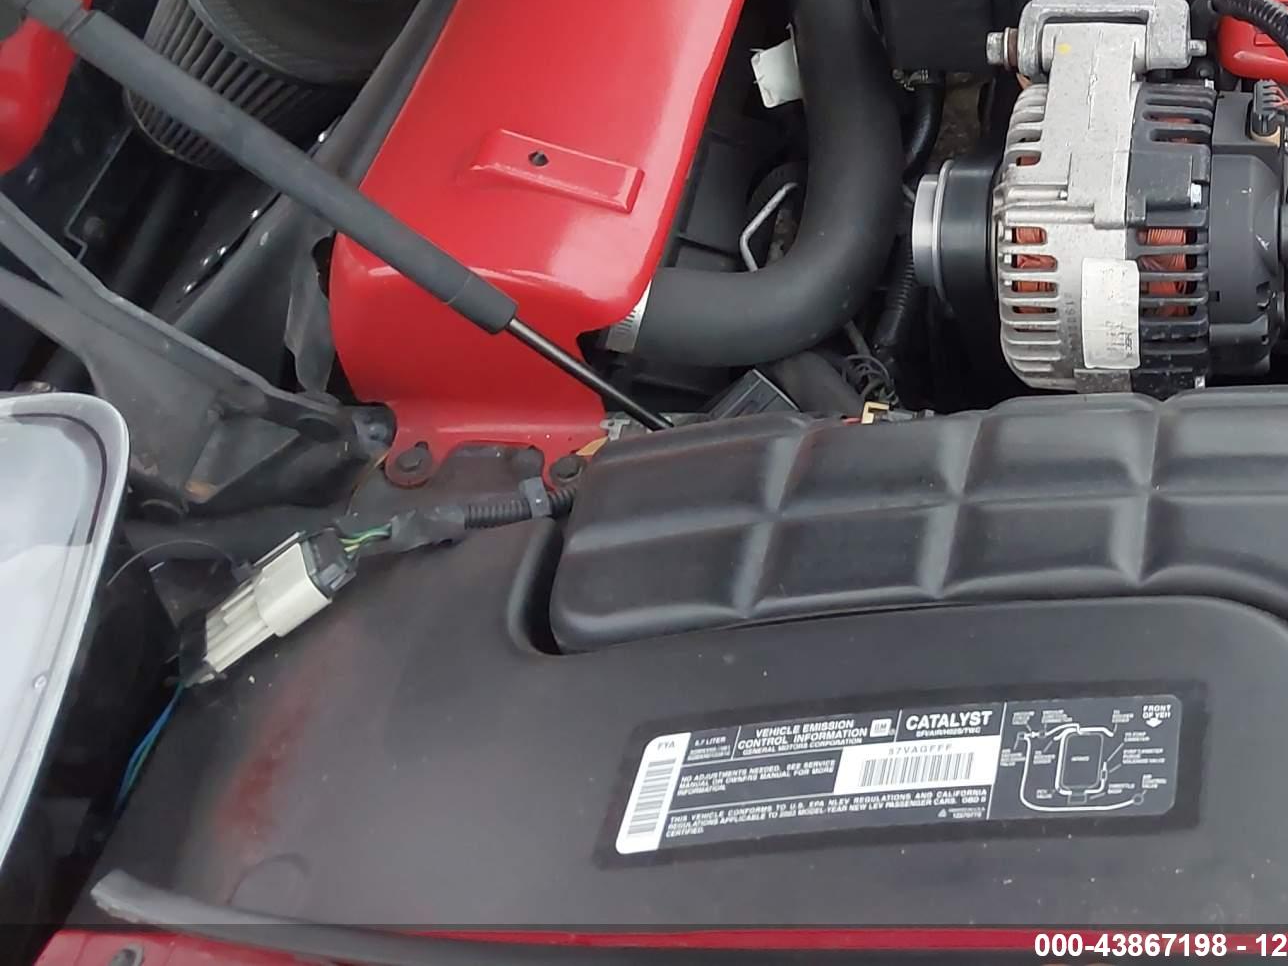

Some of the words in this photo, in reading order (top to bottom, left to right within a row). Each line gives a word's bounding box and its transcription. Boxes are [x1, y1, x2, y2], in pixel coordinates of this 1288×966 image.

[1143, 704, 1171, 712] FRONT
[756, 724, 800, 738] VEHICLE
[802, 719, 854, 733] EMISSION
[906, 711, 992, 730] CATALYST
[738, 735, 788, 750] CONTROL
[793, 727, 868, 743] INFORMATION
[743, 745, 776, 755] GENERAL
[778, 742, 808, 751] MOTORS
[809, 738, 862, 748] CORPORATION
[693, 769, 747, 781] ADJUSTMENTS
[692, 811, 724, 821] VEHICLE
[728, 806, 772, 816] CONFORMS
[853, 792, 911, 804] REGULATIONS
[915, 791, 933, 799] AND
[936, 789, 987, 798] CALIFORNIA
[720, 813, 765, 824] APPLICABLE
